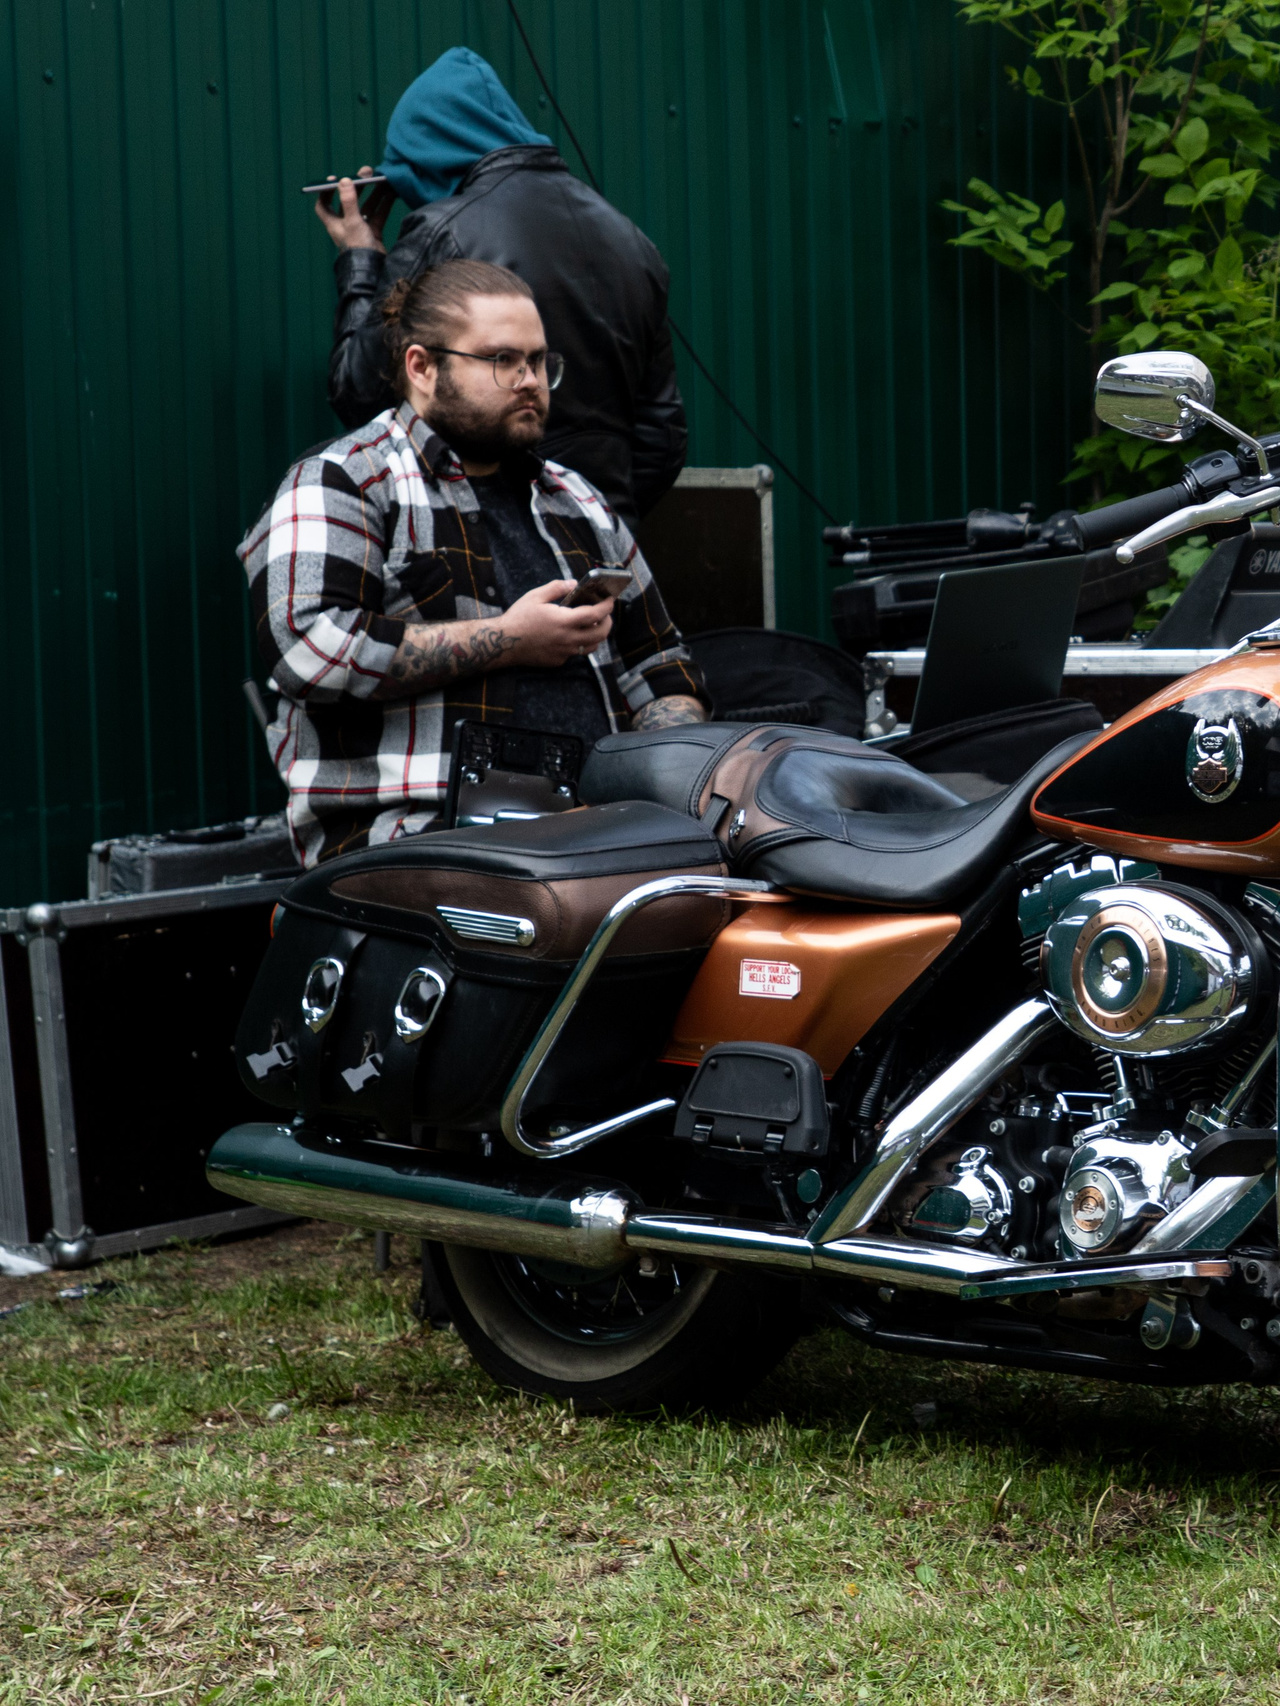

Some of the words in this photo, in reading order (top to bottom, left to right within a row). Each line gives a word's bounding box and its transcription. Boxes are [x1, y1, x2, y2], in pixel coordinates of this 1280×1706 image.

[744, 964, 766, 973] SUPPORT
[768, 965, 779, 974] YOUR
[748, 972, 766, 983] HELLS
[769, 974, 791, 985] ANGELS
